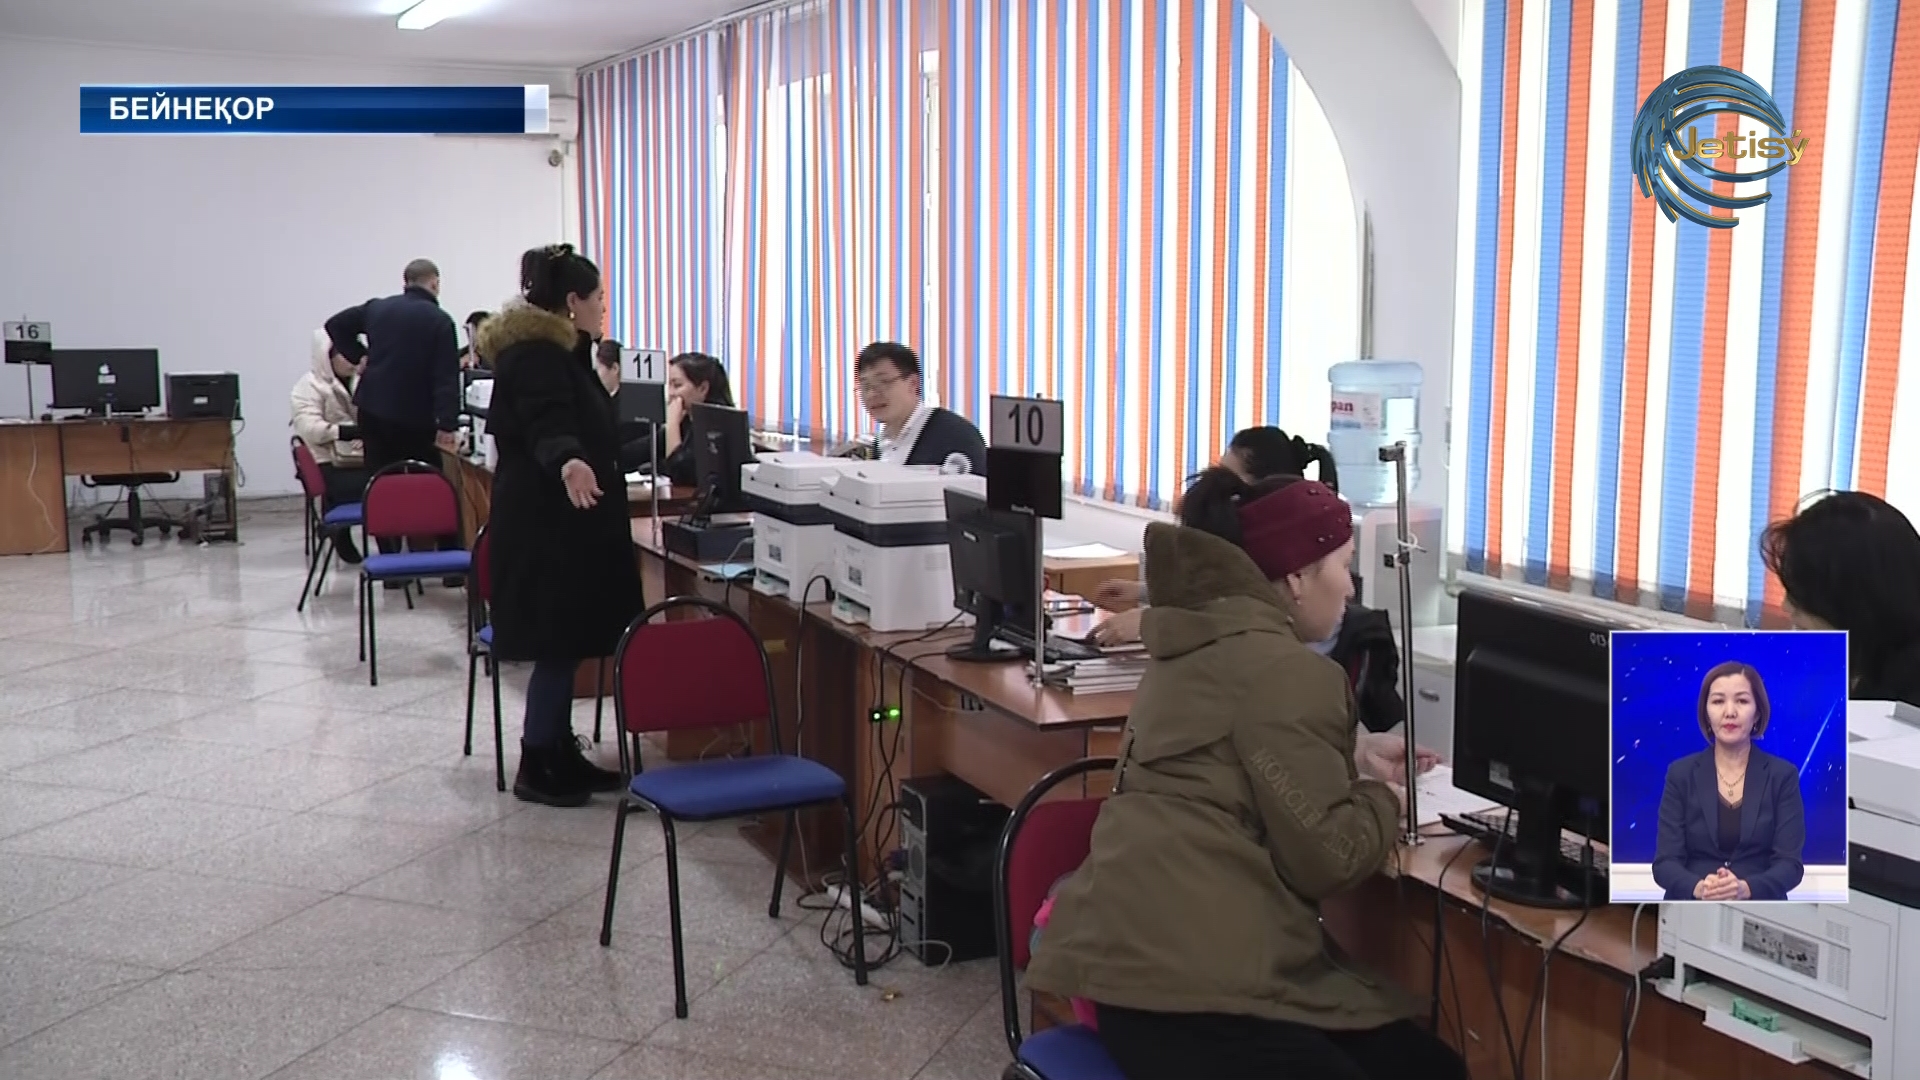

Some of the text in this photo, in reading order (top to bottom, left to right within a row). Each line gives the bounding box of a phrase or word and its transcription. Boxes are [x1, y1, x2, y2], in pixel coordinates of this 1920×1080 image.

[15, 324, 40, 339] 16
[632, 352, 652, 379] 11
[1008, 403, 1044, 446] 10
[1249, 747, 1323, 829] MONCLE
